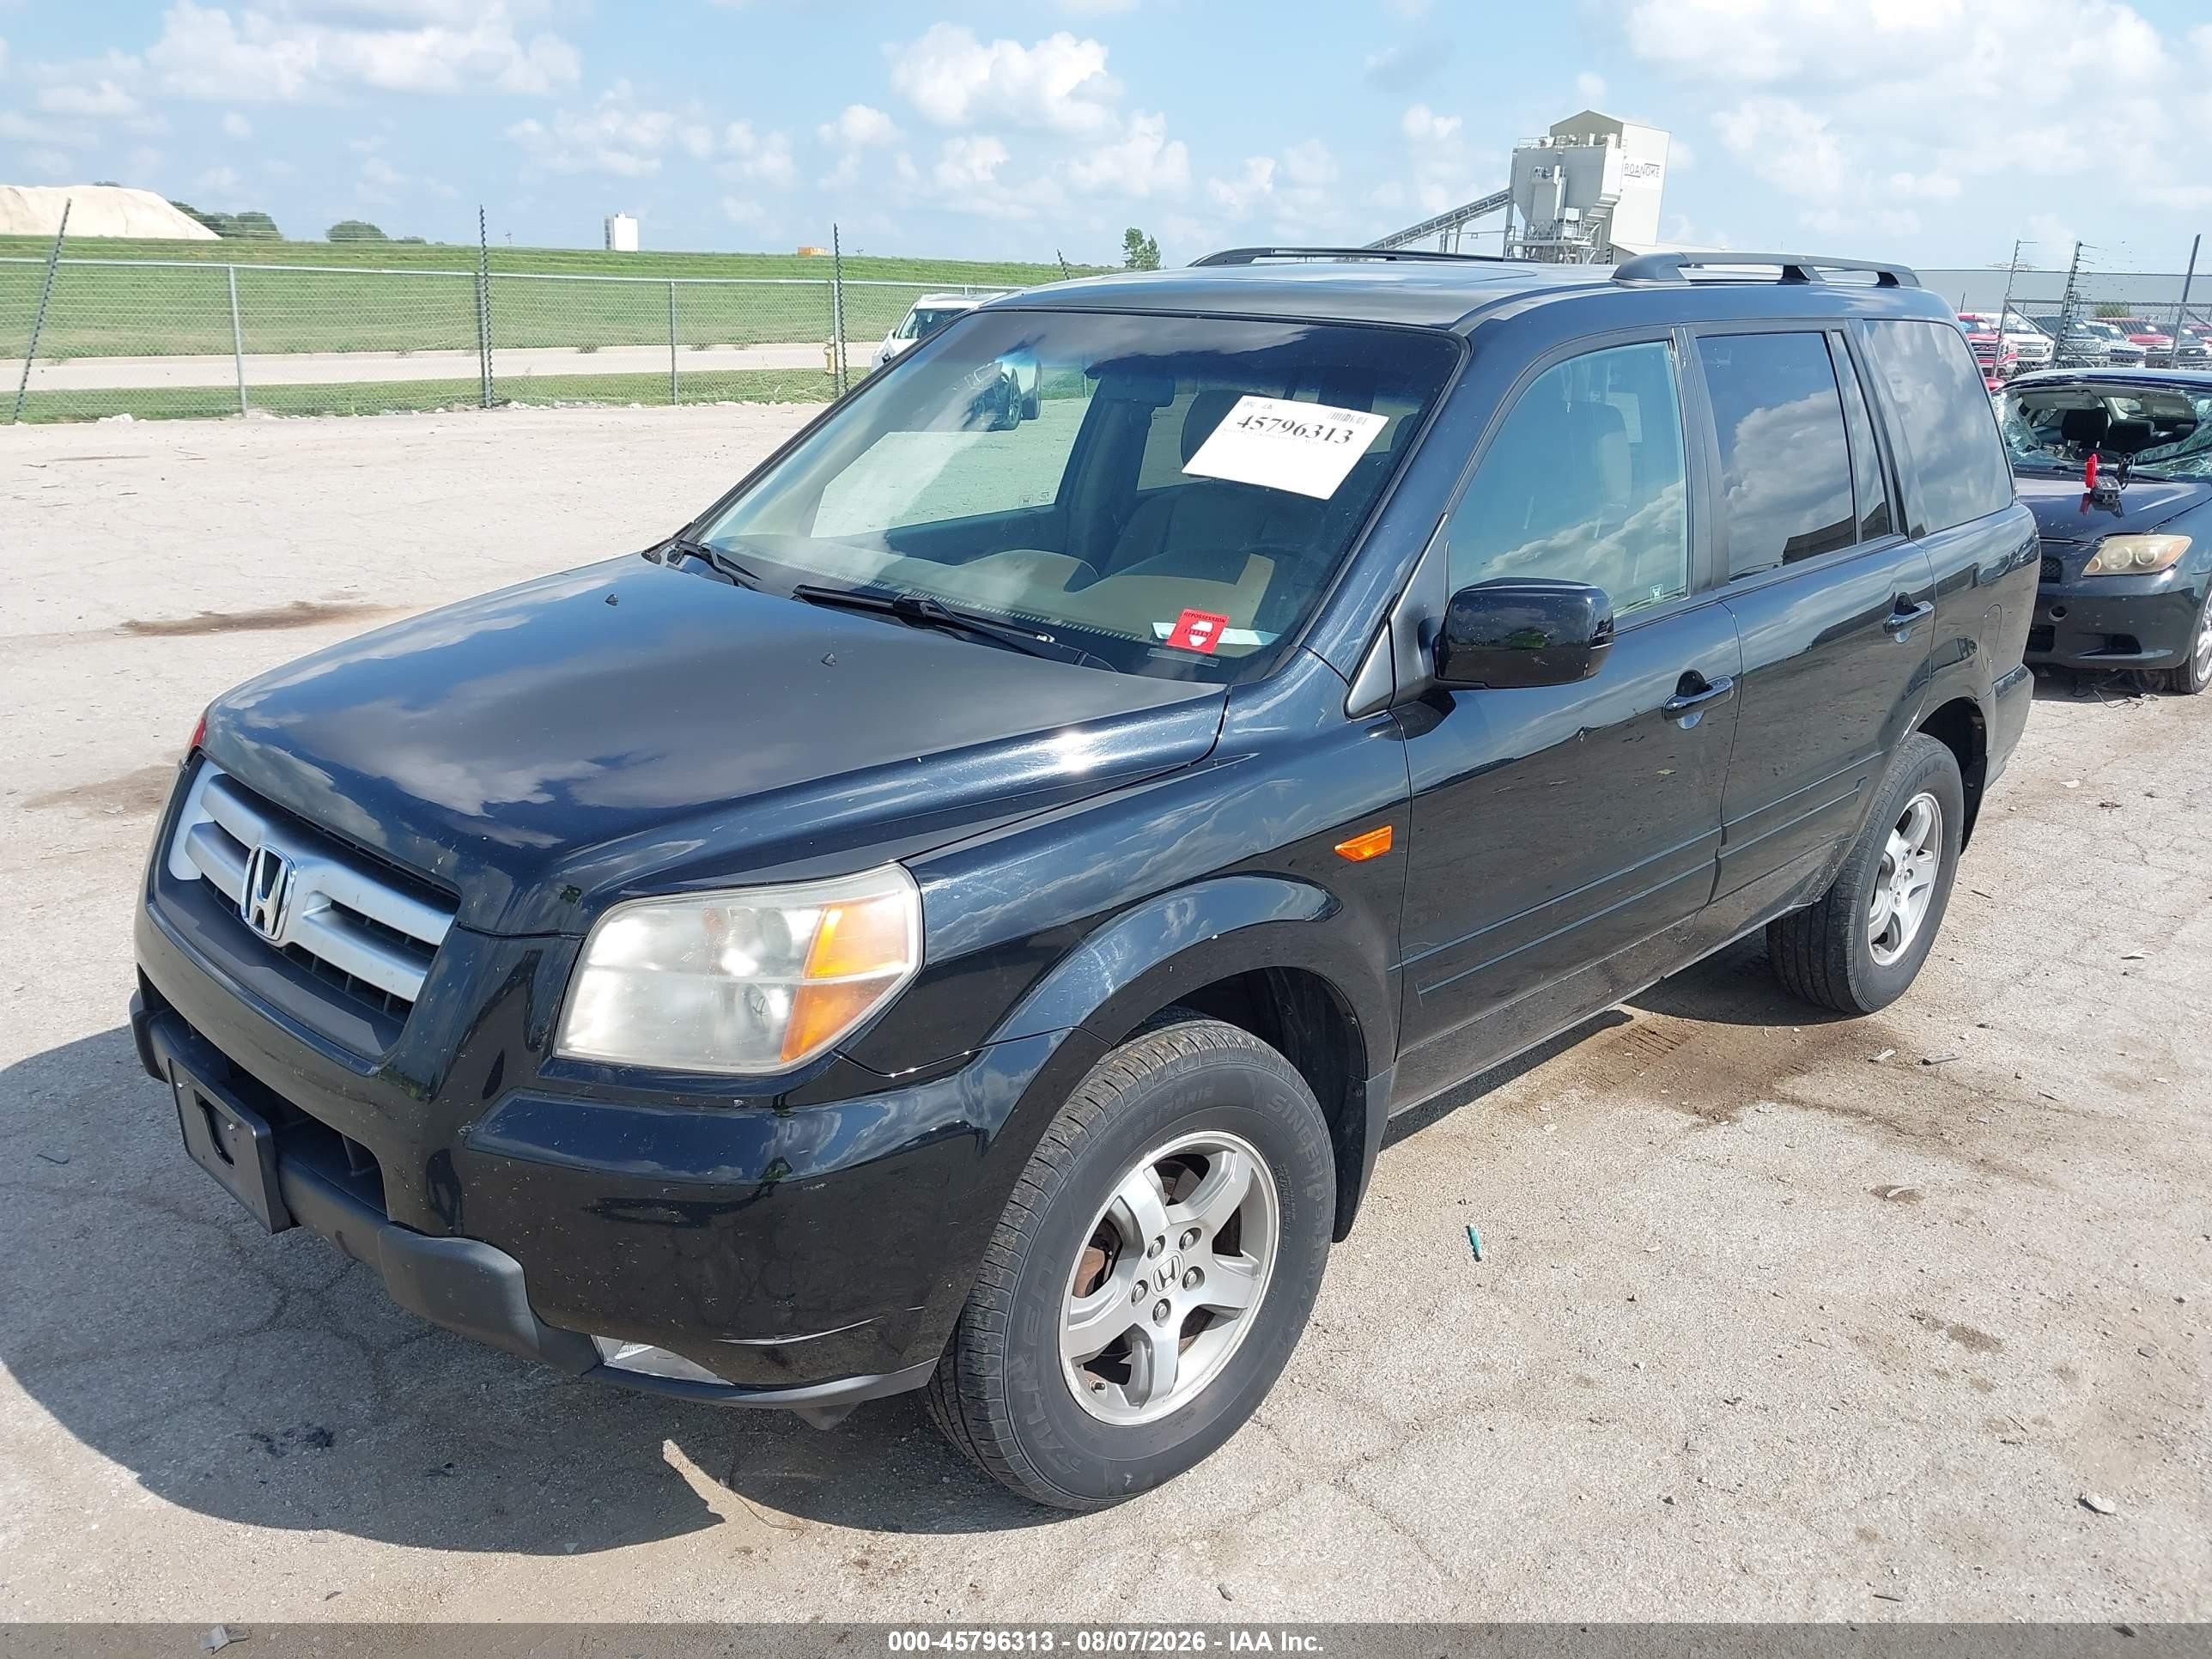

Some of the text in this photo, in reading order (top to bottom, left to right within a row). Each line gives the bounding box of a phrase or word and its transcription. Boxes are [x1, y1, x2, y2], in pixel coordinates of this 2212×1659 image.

[1625, 163, 1660, 178] ROANOKE
[1237, 415, 1354, 445] 45796313
[1184, 611, 1226, 623] REPOSSESSION
